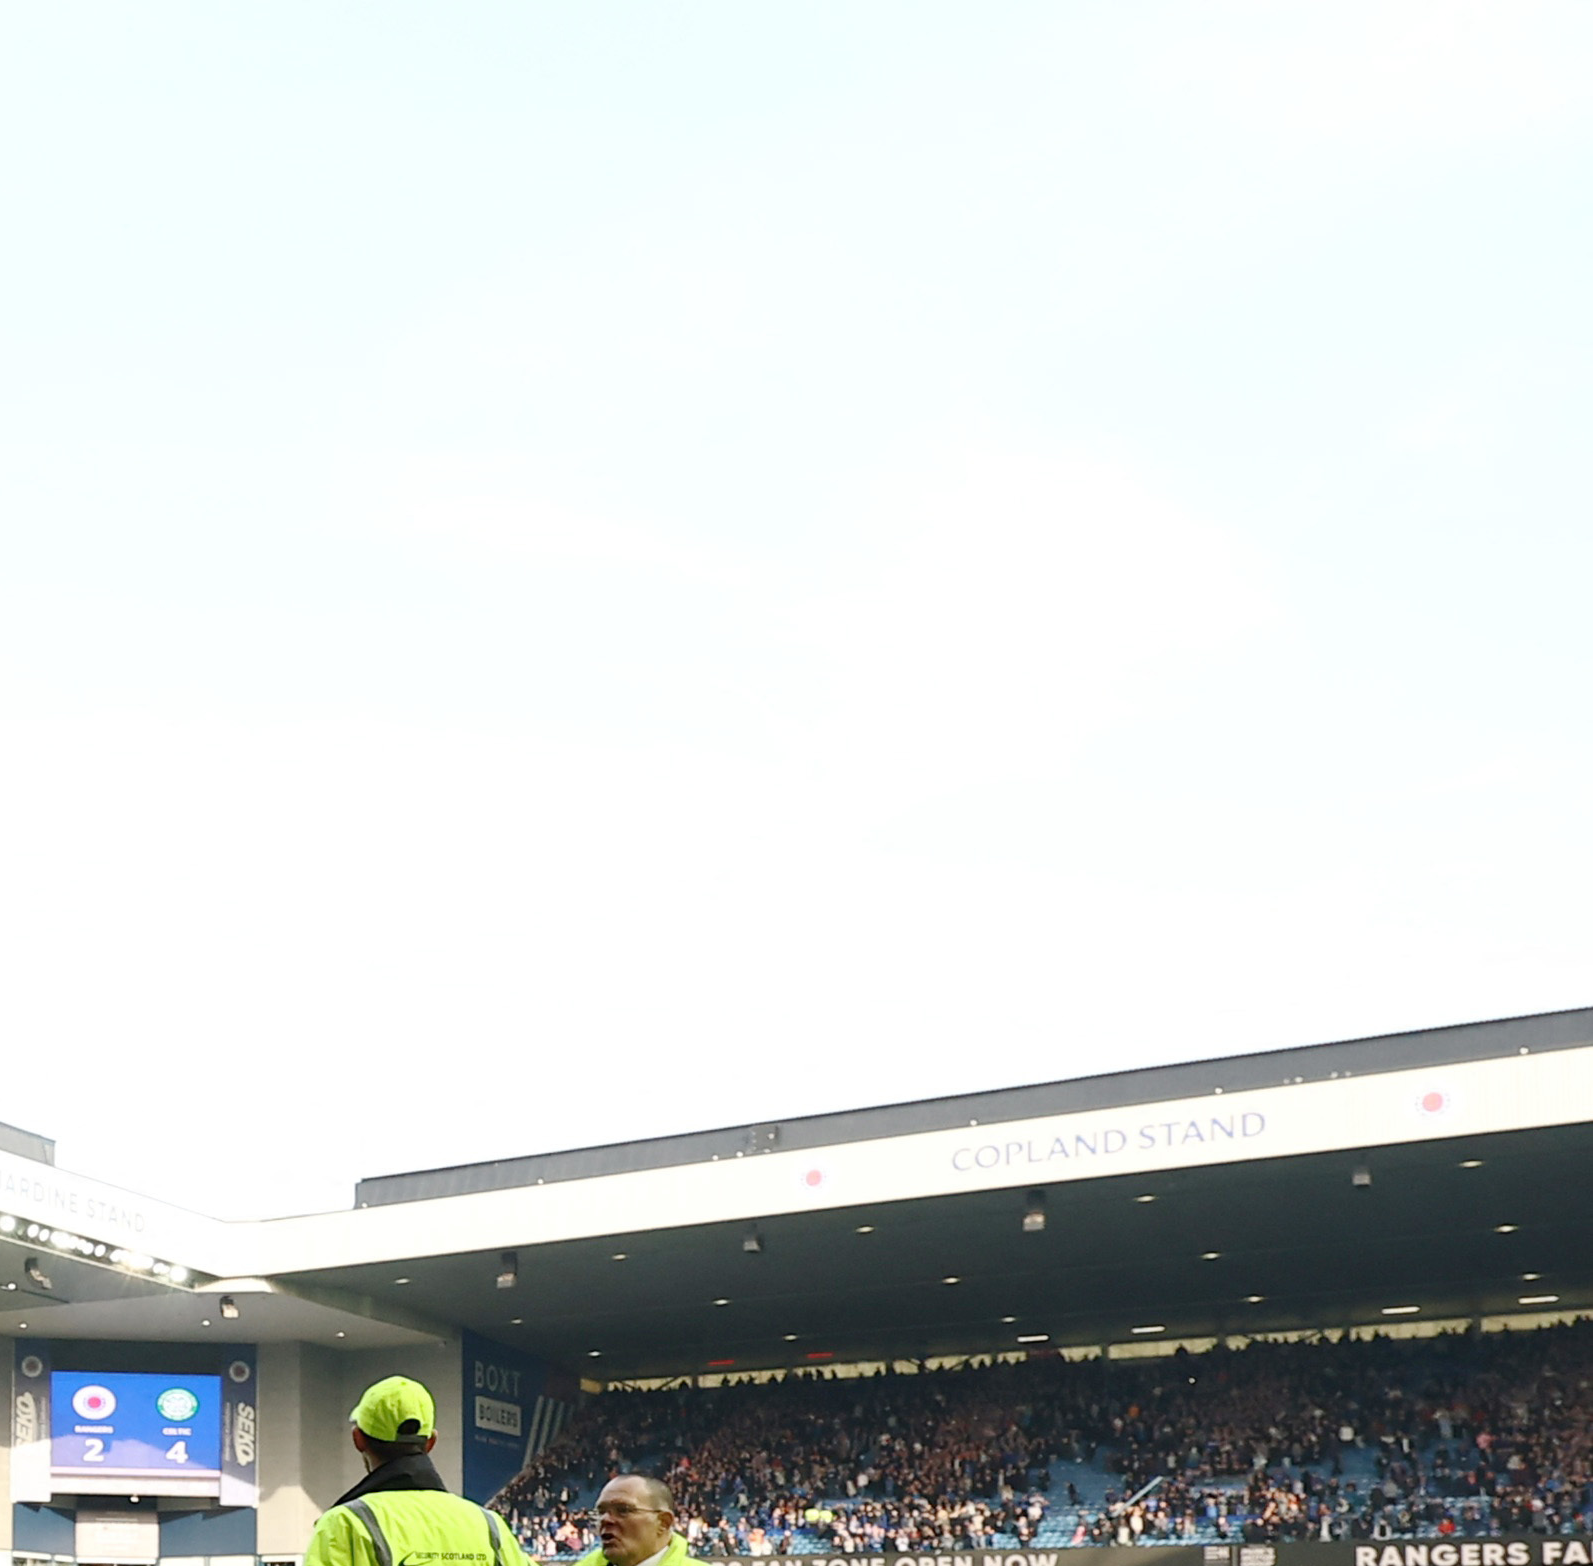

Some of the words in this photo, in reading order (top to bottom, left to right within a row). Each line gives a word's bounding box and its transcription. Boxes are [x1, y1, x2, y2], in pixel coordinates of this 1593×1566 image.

[952, 1129, 1127, 1172] COPLAND
[1138, 1111, 1266, 1149] STAND
[86, 1198, 145, 1233] STAND
[474, 1360, 521, 1397] BOXT
[83, 1438, 104, 1463] 2
[165, 1440, 189, 1465] 4
[236, 1402, 255, 1466] SEKO
[441, 1551, 474, 1561] SCOTLAND
[1542, 1540, 1593, 1566] FA
